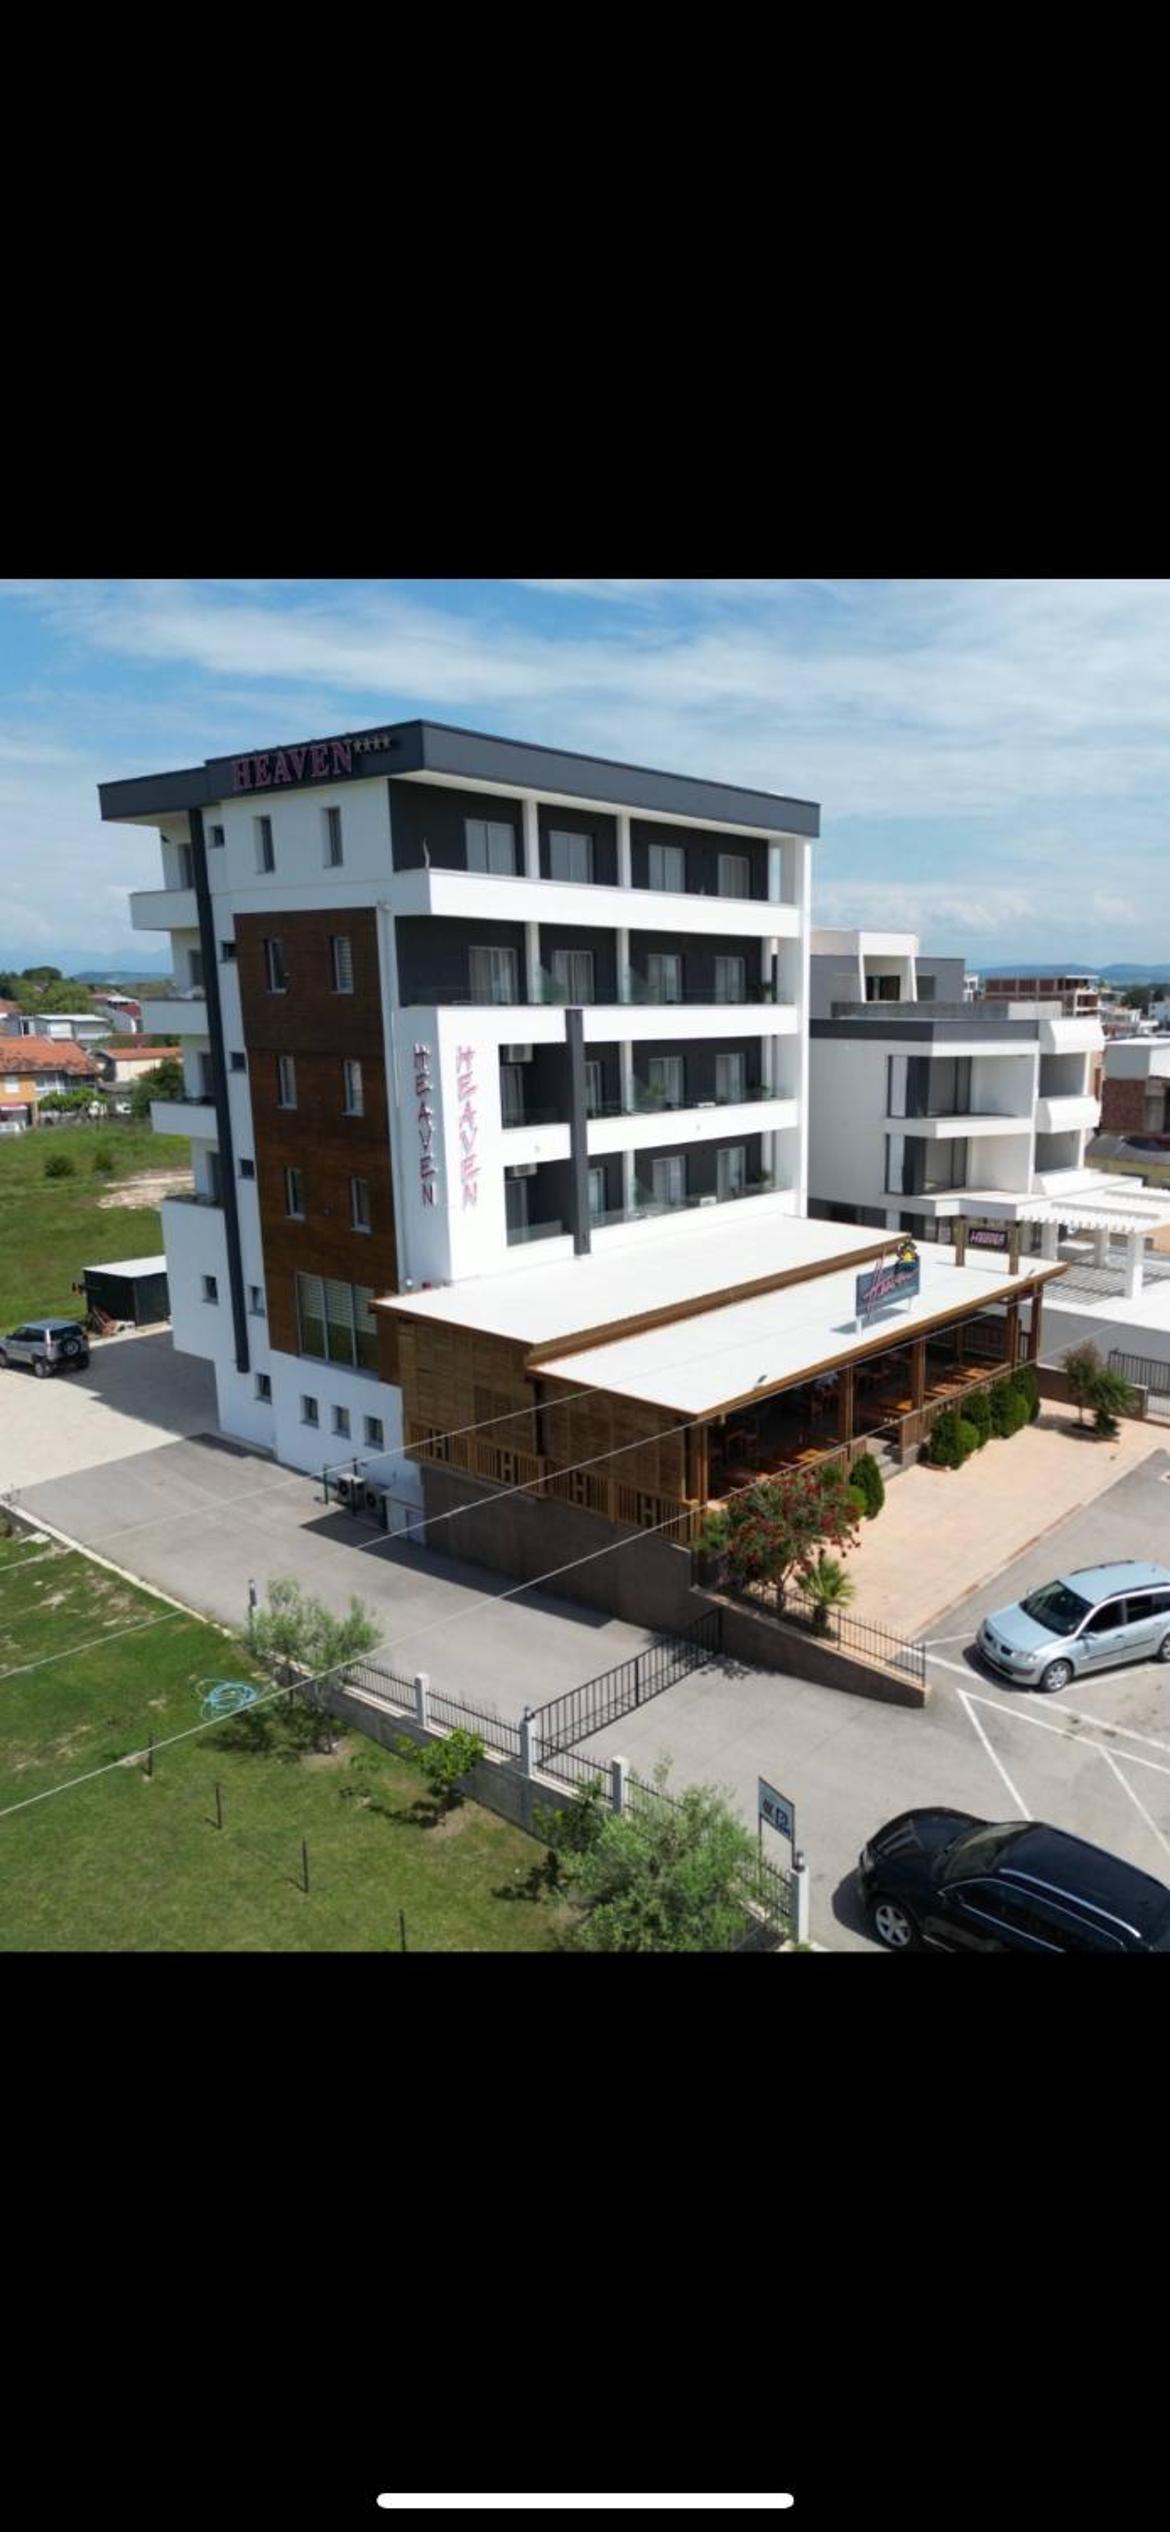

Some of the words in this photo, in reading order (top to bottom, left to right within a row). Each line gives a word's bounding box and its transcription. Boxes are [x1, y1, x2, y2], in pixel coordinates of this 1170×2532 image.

[232, 739, 353, 791] HEAVEN
[413, 1043, 438, 1206] HEAVEN
[456, 1045, 480, 1212] HEAVEN
